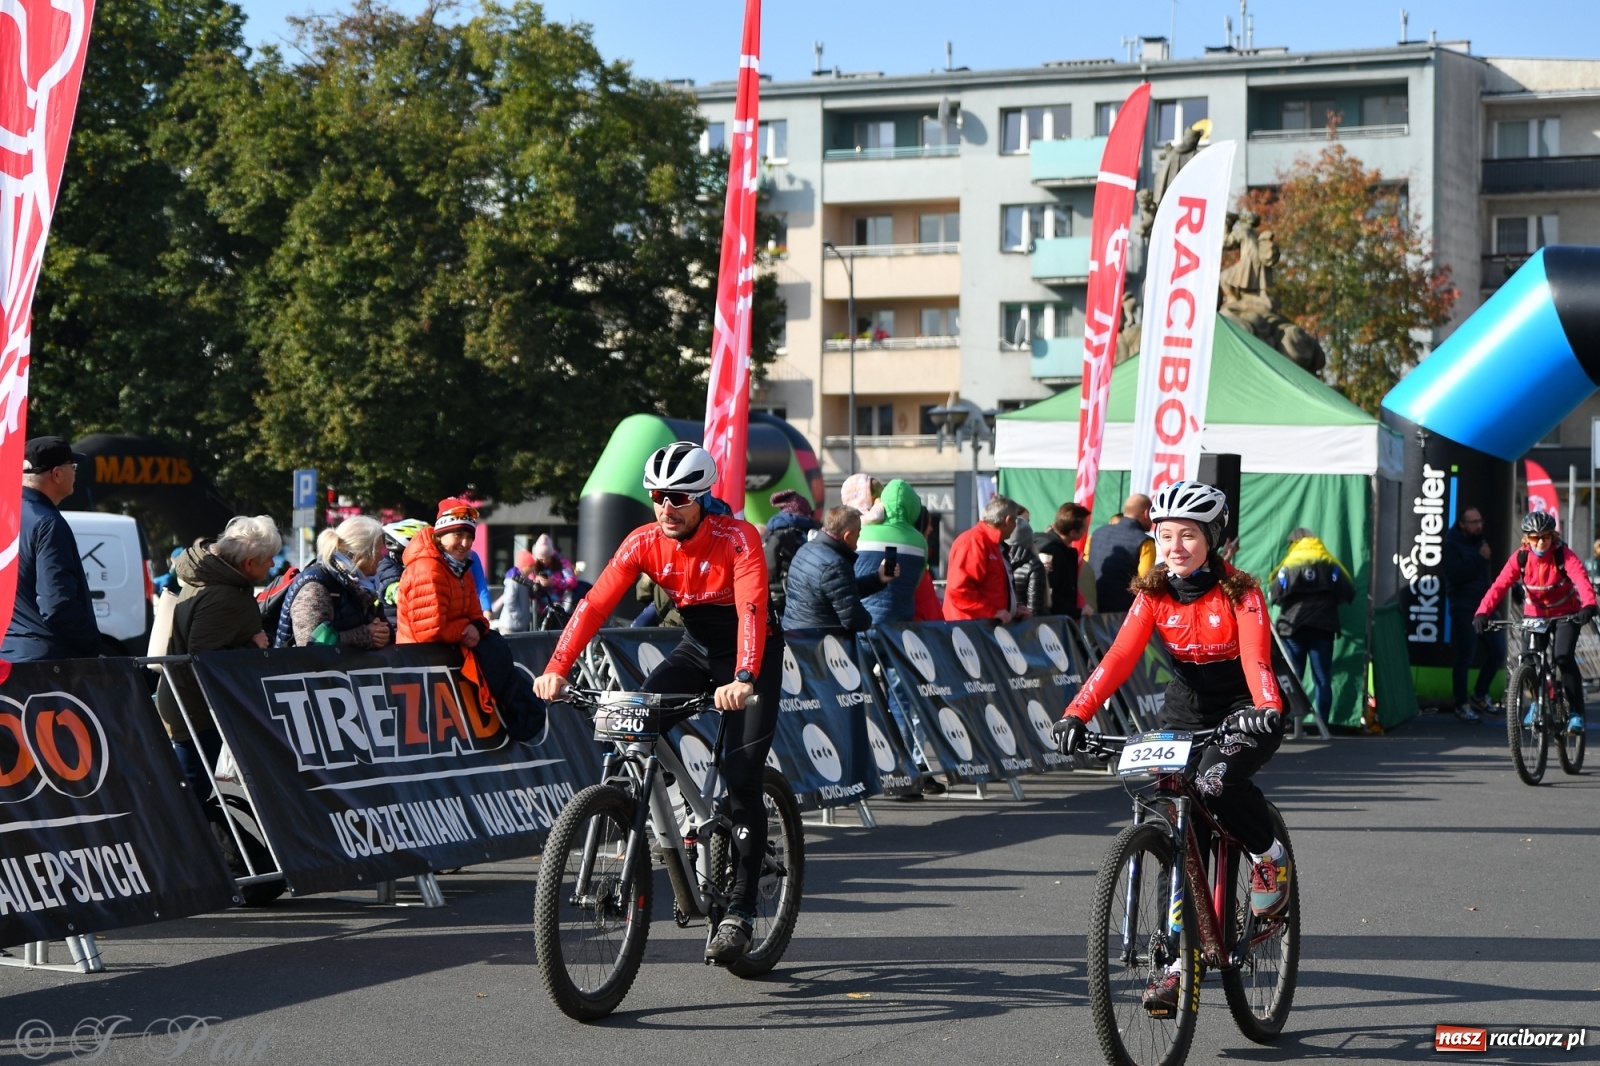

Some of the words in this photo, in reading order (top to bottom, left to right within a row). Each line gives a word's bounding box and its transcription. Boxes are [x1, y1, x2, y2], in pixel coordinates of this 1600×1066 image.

[1151, 196, 1208, 520] RACIBÓR
[95, 455, 194, 484] MAXXIS
[1413, 463, 1446, 567] atelier
[1408, 574, 1440, 643] bike
[1202, 640, 1237, 651] LIFTING
[917, 682, 953, 697] KOKOwear
[779, 697, 821, 713] KOKOwear
[268, 672, 512, 763] TREZAD
[611, 714, 645, 733] 340
[1130, 746, 1176, 763] 3246
[819, 782, 866, 800] KOKOwear
[328, 796, 477, 859] USZCZELNIAMY
